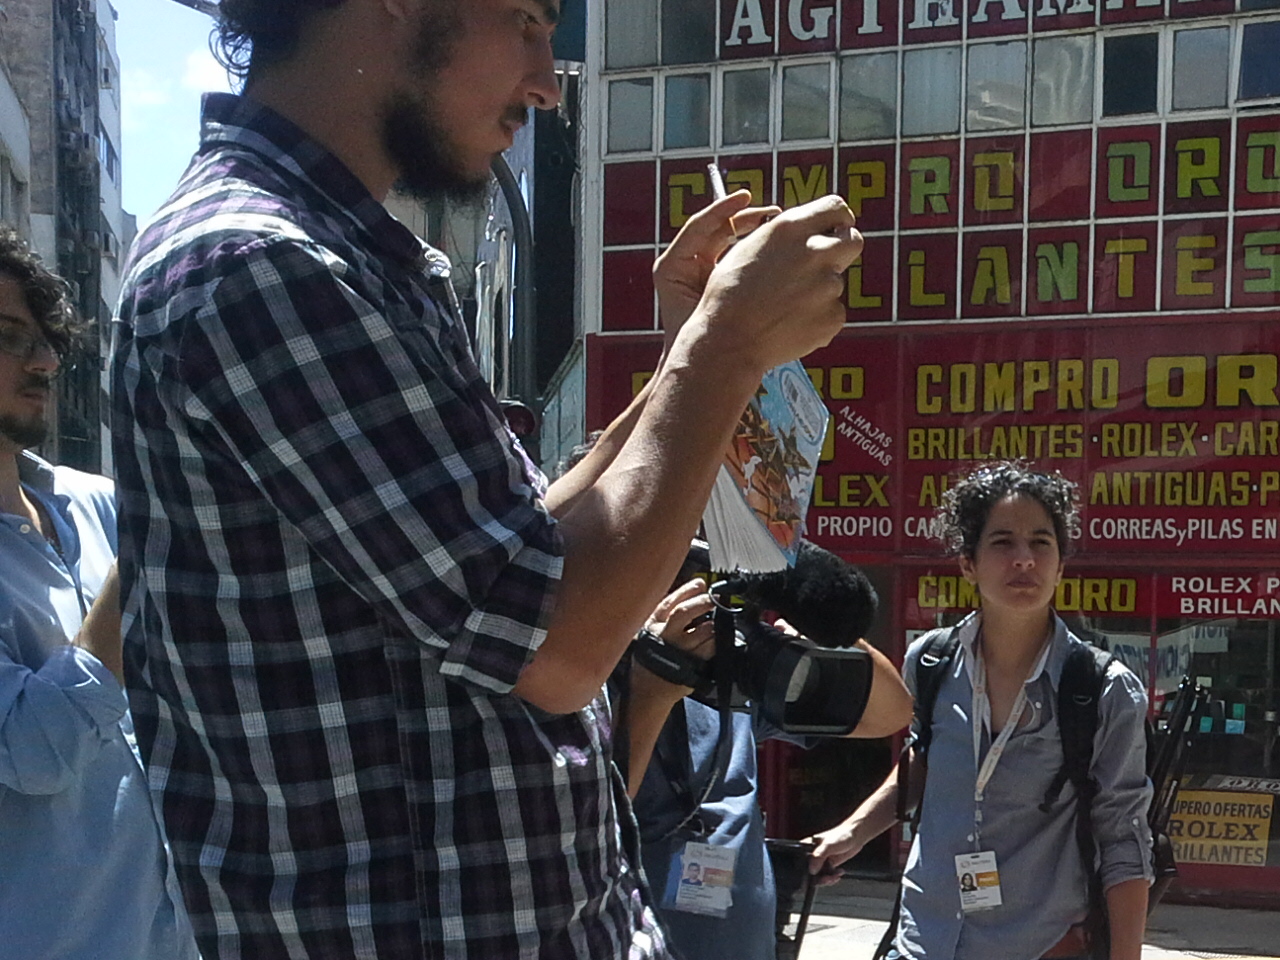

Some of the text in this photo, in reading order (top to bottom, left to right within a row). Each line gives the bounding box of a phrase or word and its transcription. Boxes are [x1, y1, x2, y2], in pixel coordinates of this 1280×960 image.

[916, 358, 1119, 414] COMPRO
[839, 405, 893, 448] ALHAJAS
[836, 421, 893, 467] ANTIGUAS
[908, 424, 1083, 460] BRILLANTES
[1102, 422, 1198, 457] ROLEX
[1090, 471, 1250, 506] ANTIGUAS
[817, 516, 893, 537] PROPIO
[1251, 518, 1277, 540] EN
[1055, 578, 1136, 612] ORO
[1172, 577, 1252, 594] ROLEX
[1213, 802, 1271, 819] OFERTAS
[1169, 820, 1260, 841] ROLEX
[1173, 843, 1265, 864] RILLANTES
